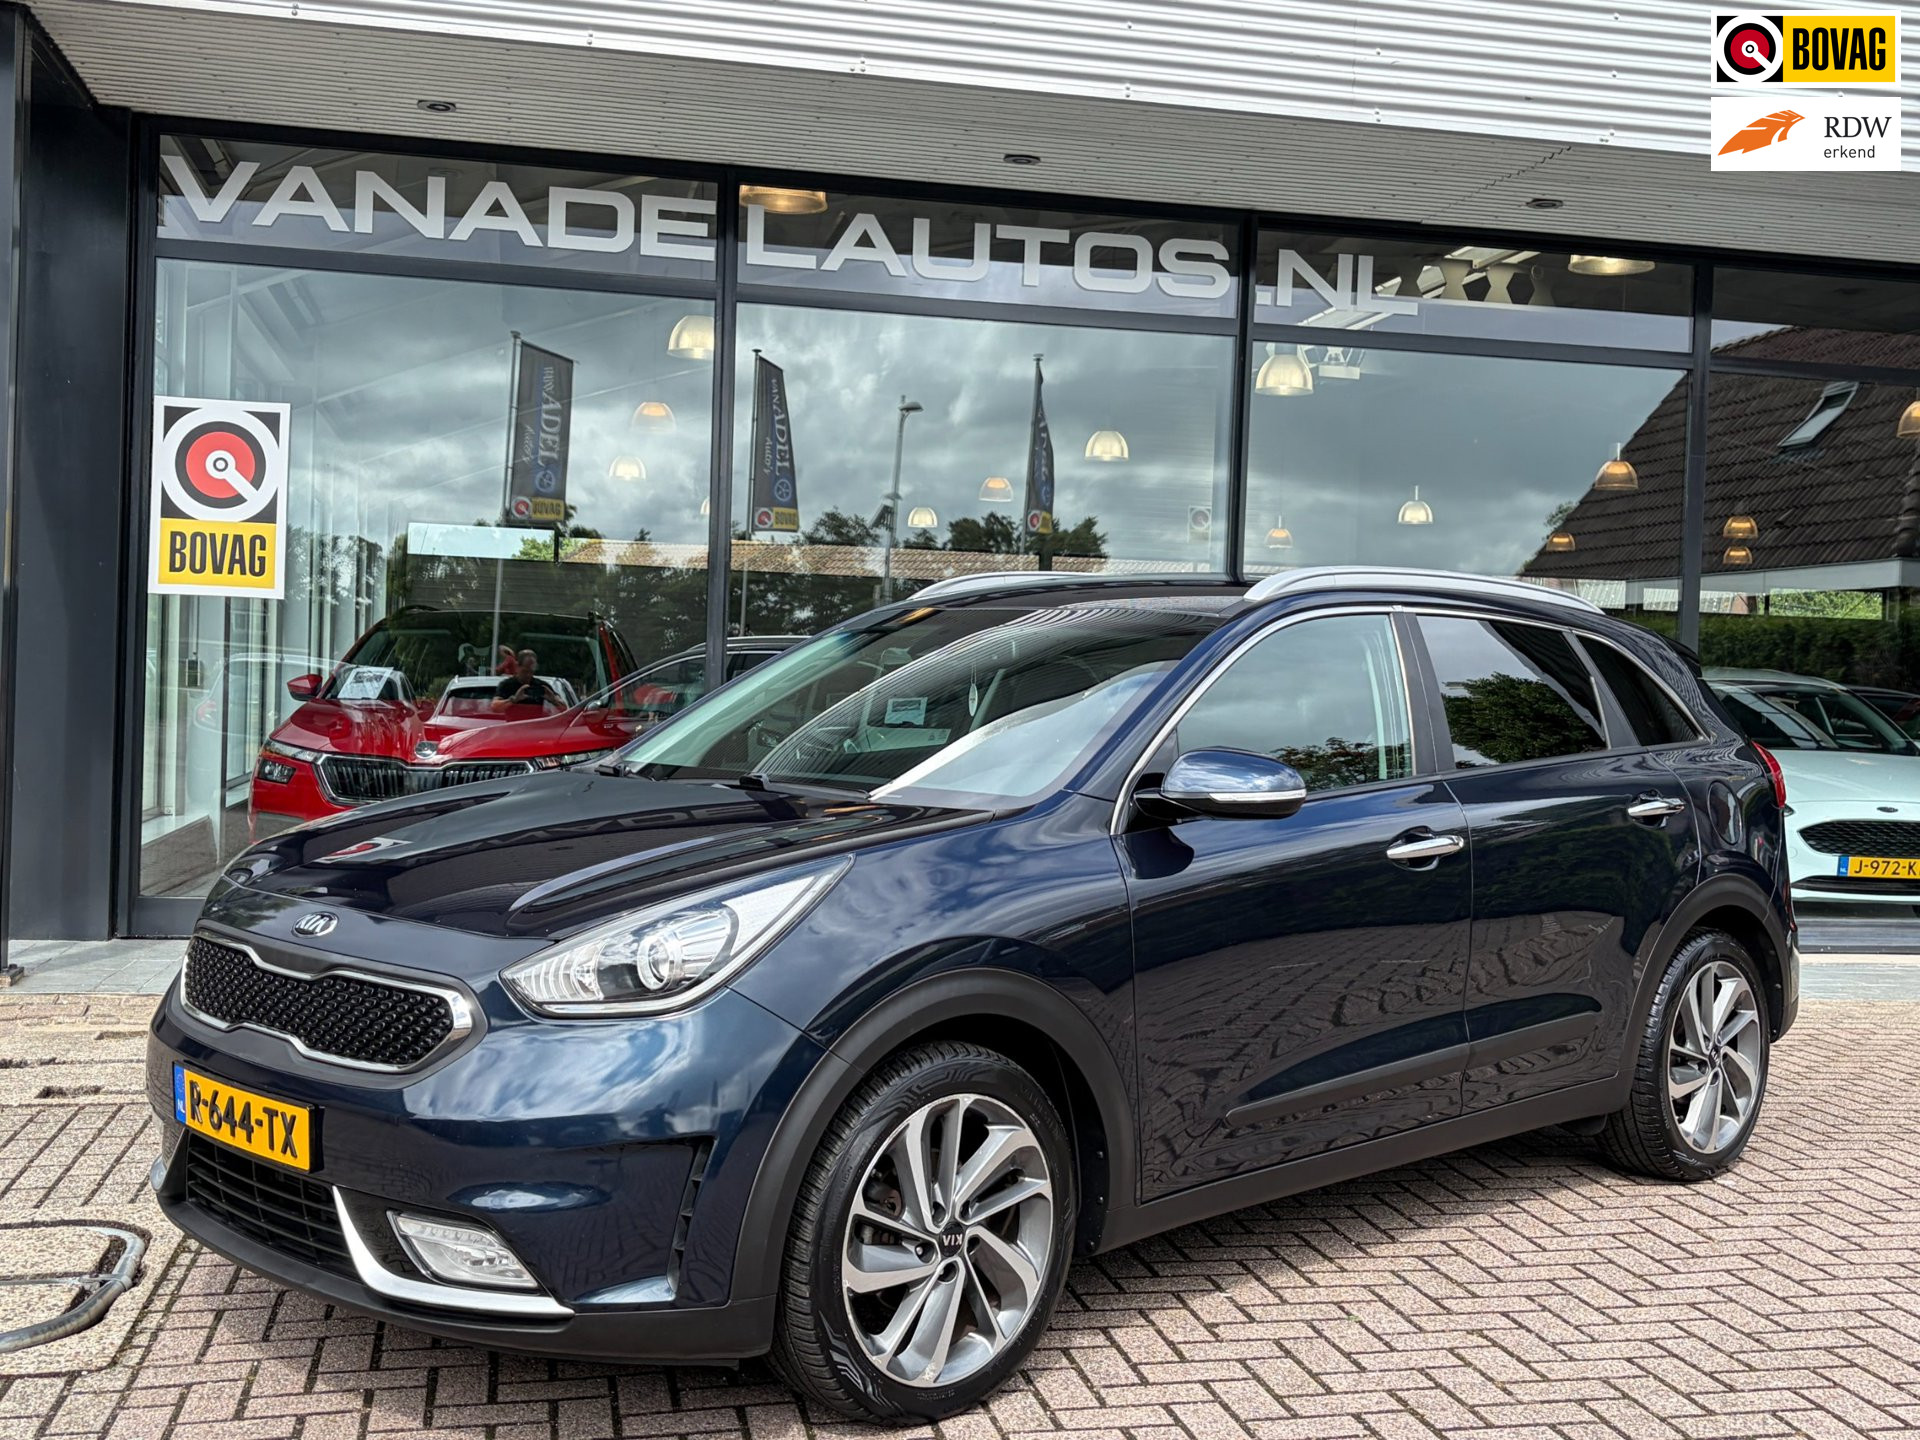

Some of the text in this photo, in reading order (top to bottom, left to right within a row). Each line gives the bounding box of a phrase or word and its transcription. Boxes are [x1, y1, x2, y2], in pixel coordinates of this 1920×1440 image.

[168, 530, 267, 577] BOVAG
[1854, 859, 1920, 876] J-972-K
[295, 913, 330, 933] KIA
[189, 1079, 298, 1159] R-644-TX
[942, 1233, 963, 1246] KIA
